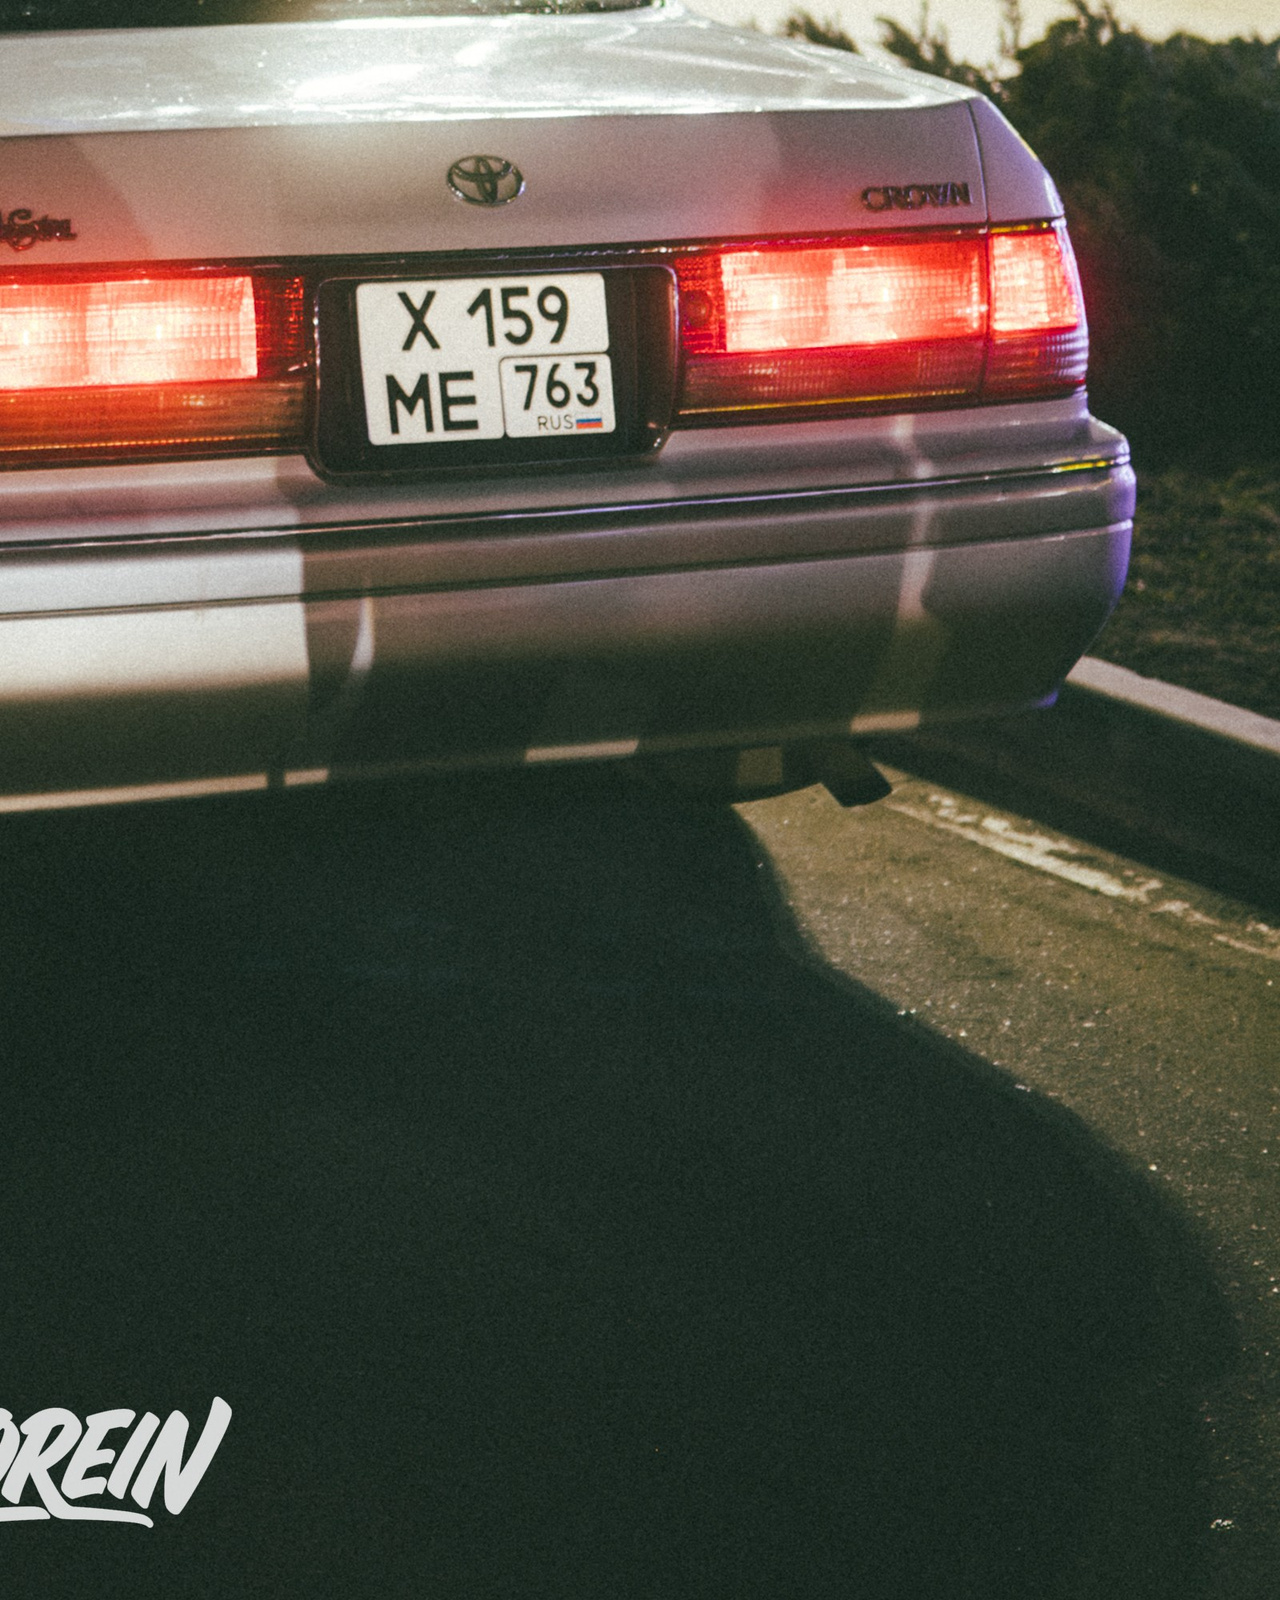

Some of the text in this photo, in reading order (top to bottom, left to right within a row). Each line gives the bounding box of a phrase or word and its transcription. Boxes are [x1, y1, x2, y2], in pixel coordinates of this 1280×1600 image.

[861, 182, 972, 212] CROWN
[397, 285, 570, 351] X 159
[385, 370, 480, 436] ME
[514, 361, 600, 412] 763
[537, 414, 574, 431] RUS
